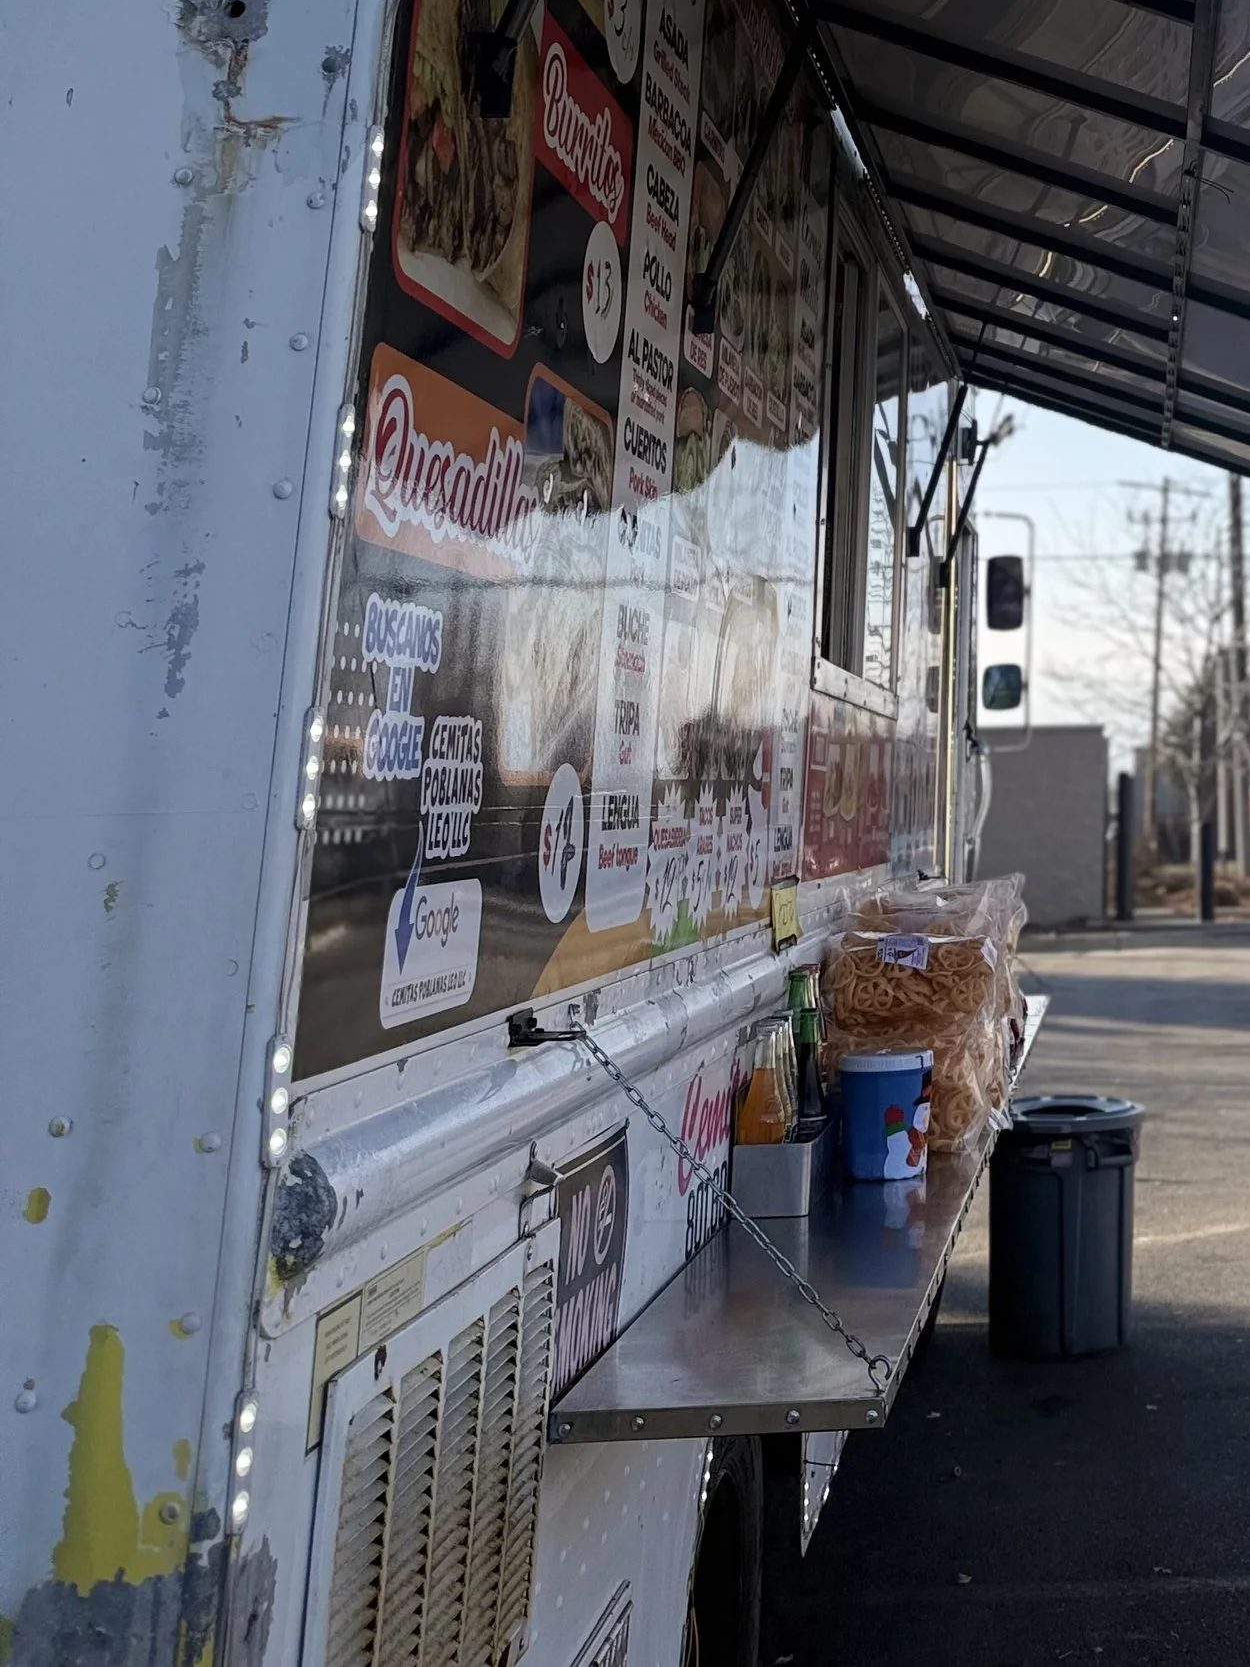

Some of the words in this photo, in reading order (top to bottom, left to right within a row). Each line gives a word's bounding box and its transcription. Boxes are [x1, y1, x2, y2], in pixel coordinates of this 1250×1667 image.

[660, 8, 688, 71] ASADA
[547, 53, 622, 215] Burritos
[645, 72, 692, 157] BARBACOA
[646, 202, 661, 233] Beef
[647, 163, 679, 227] CABEZA
[586, 258, 613, 319] $13
[643, 250, 672, 303] POLLO
[644, 293, 668, 330] Chicken
[628, 327, 641, 365] AL
[643, 338, 674, 393] PASTOR
[624, 415, 667, 475] CUERITOS
[371, 388, 541, 561] Quesadillas
[629, 466, 646, 496] Pork
[366, 601, 440, 666] BUSCANOS
[617, 603, 651, 646] BUCHE
[391, 666, 410, 712] EN
[615, 699, 640, 736] TRIPA
[367, 718, 422, 773] GOOGLE
[423, 766, 481, 808] POBLANAS
[602, 794, 640, 832] LENGUA
[428, 811, 450, 851] LEO
[449, 811, 470, 848] LLC
[598, 844, 615, 870] Beef
[615, 846, 639, 872] tongue
[415, 891, 460, 948] Google
[418, 975, 448, 999] POBLANAS
[564, 1184, 591, 1286] NO
